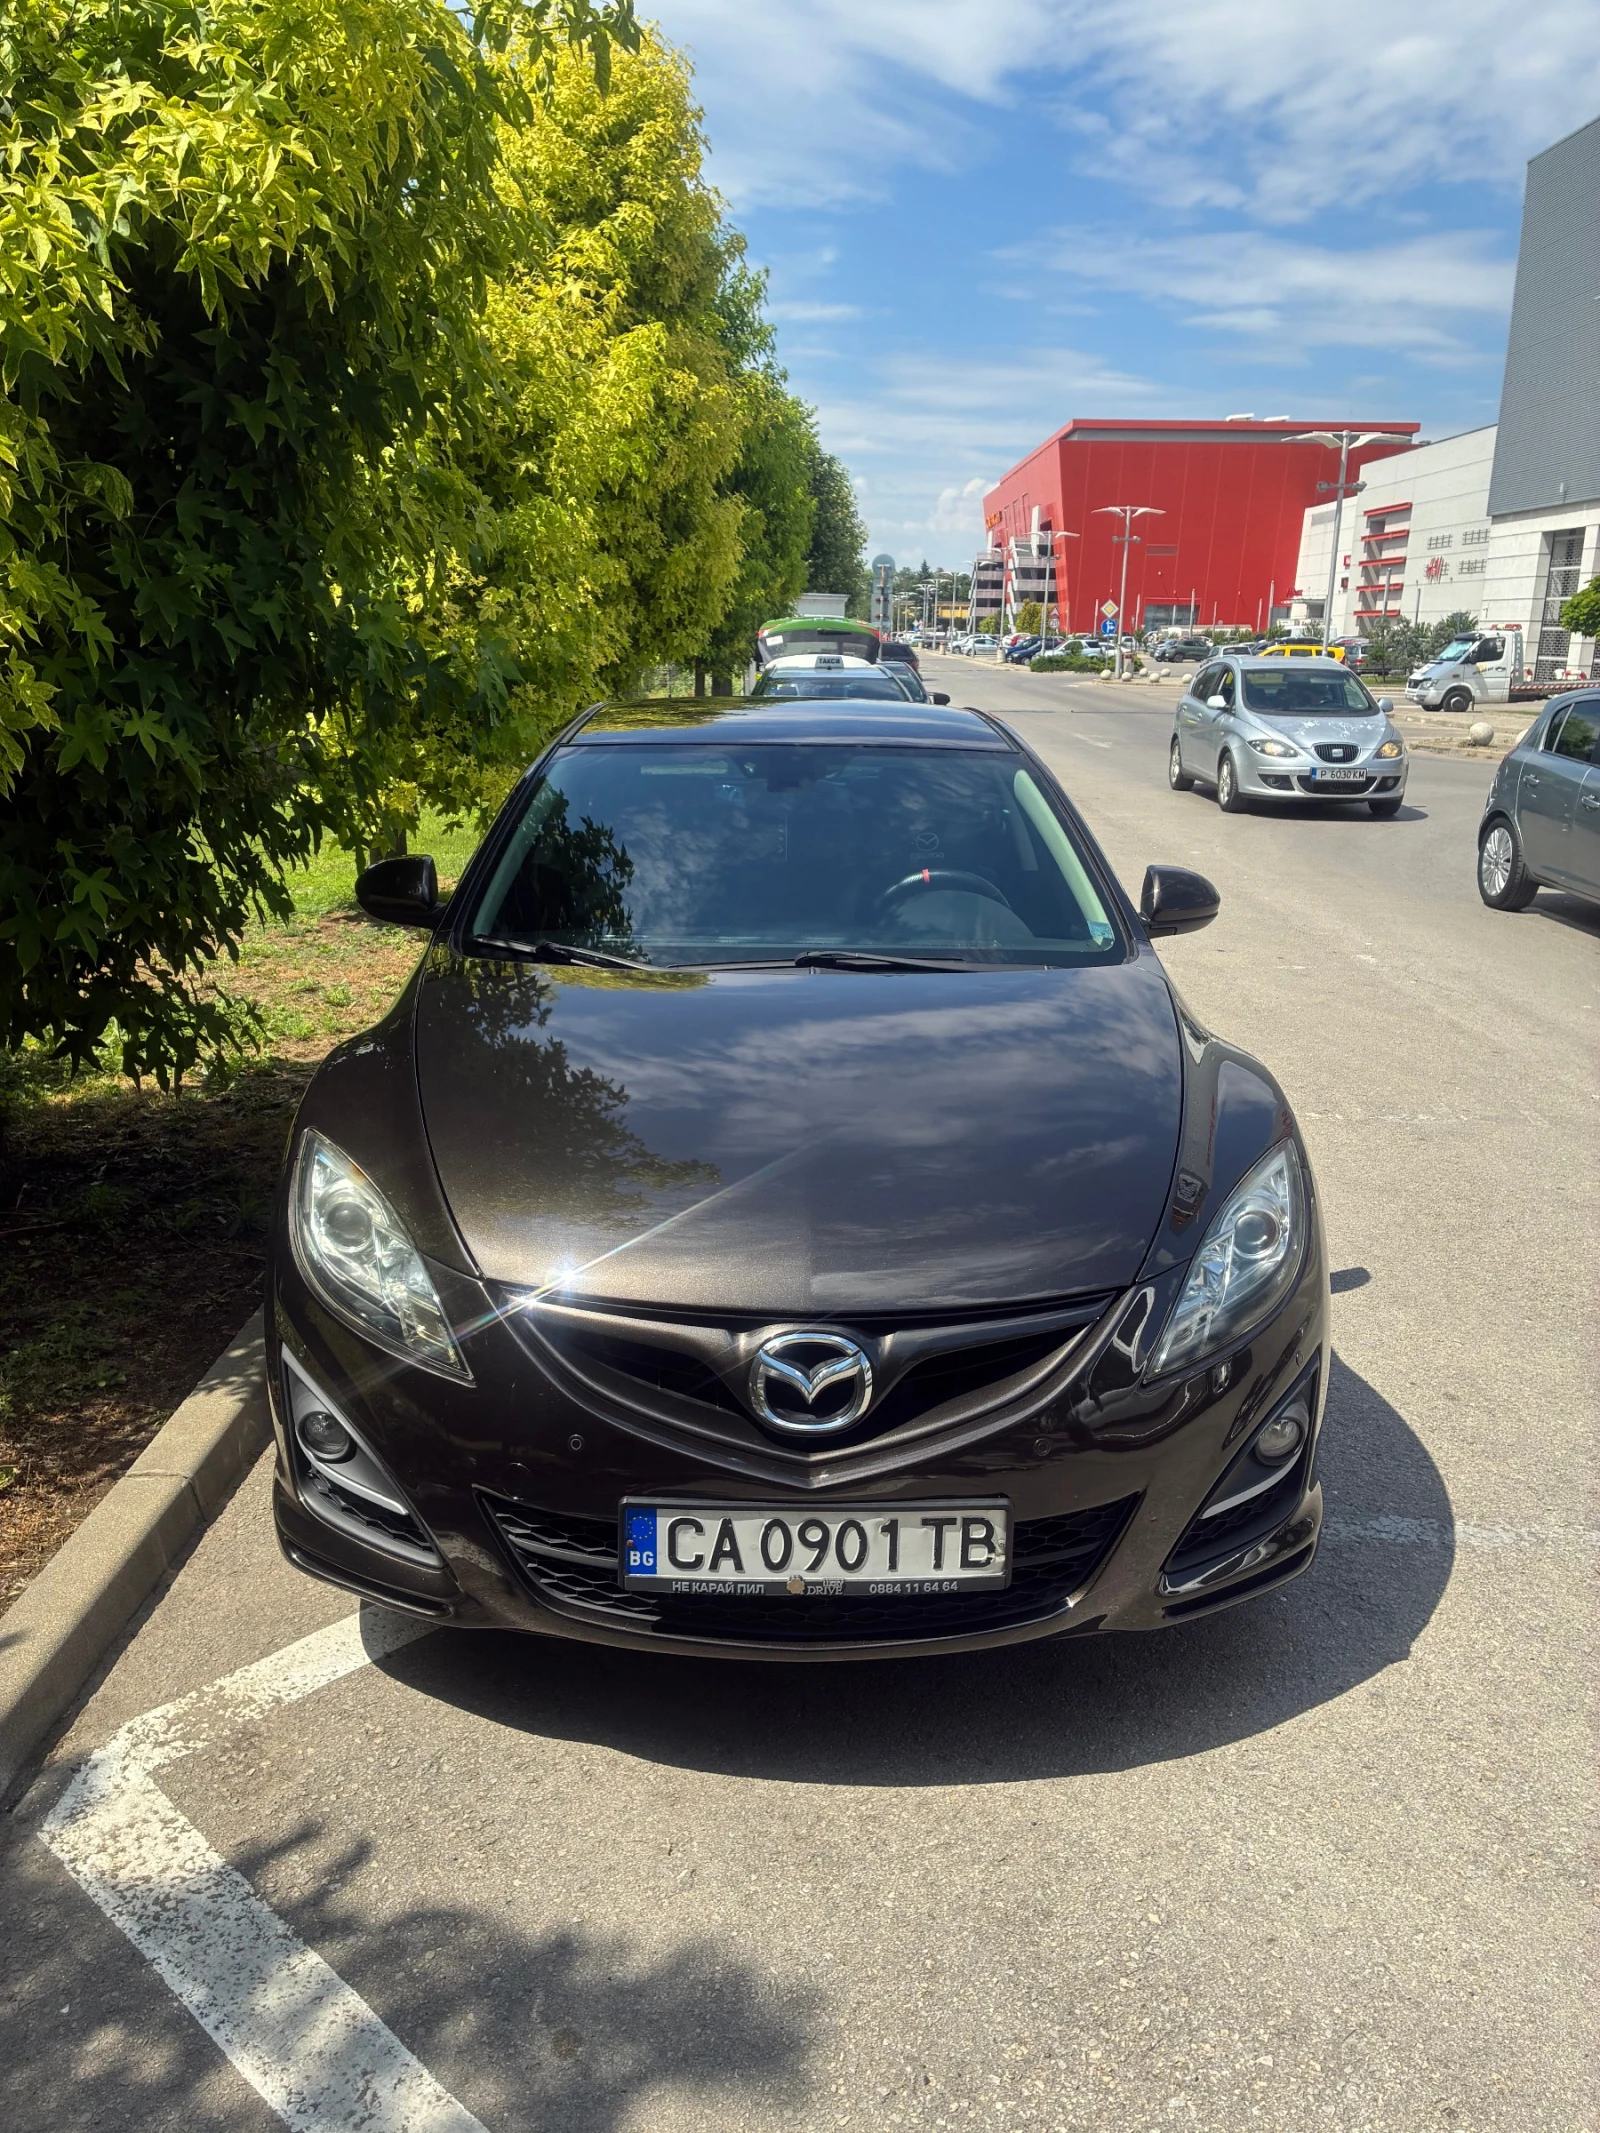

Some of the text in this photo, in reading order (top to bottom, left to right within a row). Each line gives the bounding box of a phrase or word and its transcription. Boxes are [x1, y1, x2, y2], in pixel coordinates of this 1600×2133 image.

[1330, 770, 1352, 779] 6030
[1353, 771, 1365, 779] KM
[667, 1516, 997, 1573] CA 0901 TB
[629, 1551, 654, 1567] BG
[672, 1580, 765, 1595] НЕ КАРАЙ ПИЛ
[806, 1585, 843, 1596] DRIVE
[869, 1580, 959, 1594] 0884 11 64 64
